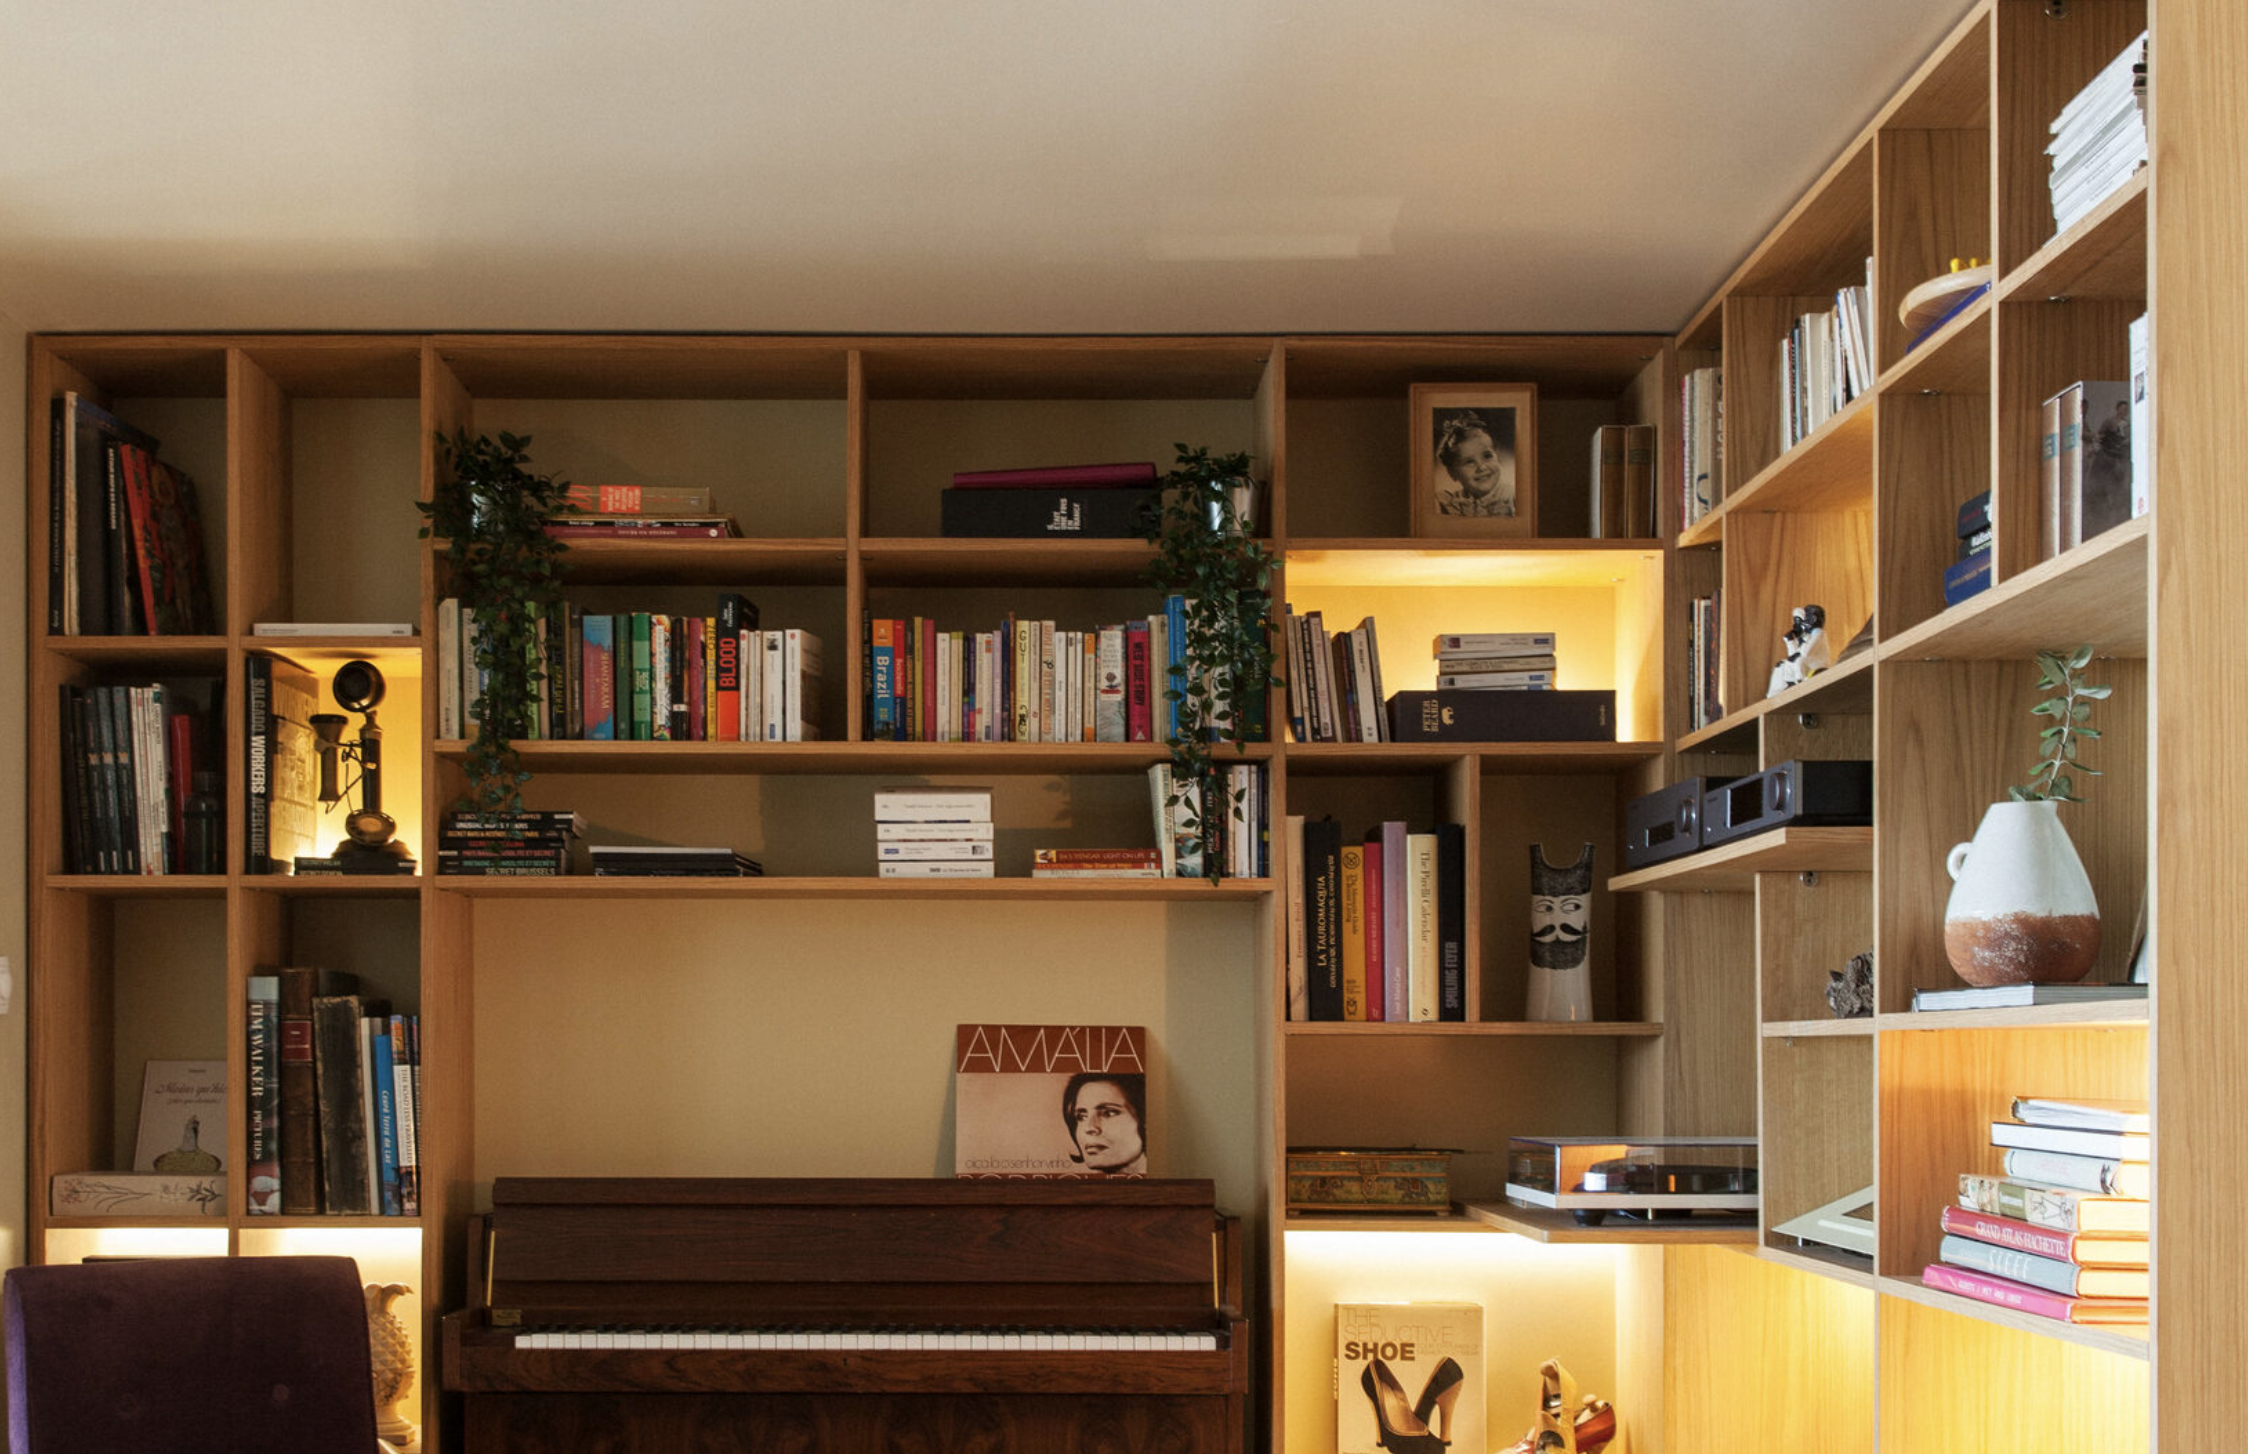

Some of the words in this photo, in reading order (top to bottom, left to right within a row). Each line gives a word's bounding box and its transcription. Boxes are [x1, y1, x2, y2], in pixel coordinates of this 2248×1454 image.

[600, 652, 610, 709] SHANTARAM
[719, 637, 736, 688] BLOOD
[876, 655, 890, 699] Brazil
[251, 678, 265, 731] SALGADO
[1423, 700, 1431, 731] PETER
[1430, 699, 1439, 732] BEARD
[250, 735, 266, 794] WORKERS
[251, 797, 266, 857] APERTURE
[484, 867, 515, 876] SECRET
[516, 867, 556, 876] BRUSSELS
[1419, 850, 1430, 869] The
[1420, 870, 1431, 898] Pirelli
[1316, 876, 1328, 952] TAUROMAQUIA
[1420, 899, 1431, 943] Calendar
[1445, 941, 1458, 968] FLYER
[1445, 969, 1458, 1009] SMILING
[251, 1001, 264, 1030] TIM
[251, 1033, 264, 1097] WALKER
[960, 1026, 1144, 1073] AMÁLIA
[252, 1110, 263, 1161] PICTURES
[383, 1115, 391, 1135] Terra
[384, 1138, 391, 1147] da
[384, 1150, 392, 1164] Luz
[404, 1124, 412, 1163] TRAVELLED
[1975, 1221, 2000, 1239] GRAND
[2001, 1226, 2025, 1246] ATLAS
[2025, 1231, 2066, 1257] HACHETTE
[1343, 1307, 1380, 1324] THE
[1343, 1323, 1454, 1344] SEDUCTIVE
[1344, 1340, 1416, 1361] SHOE
